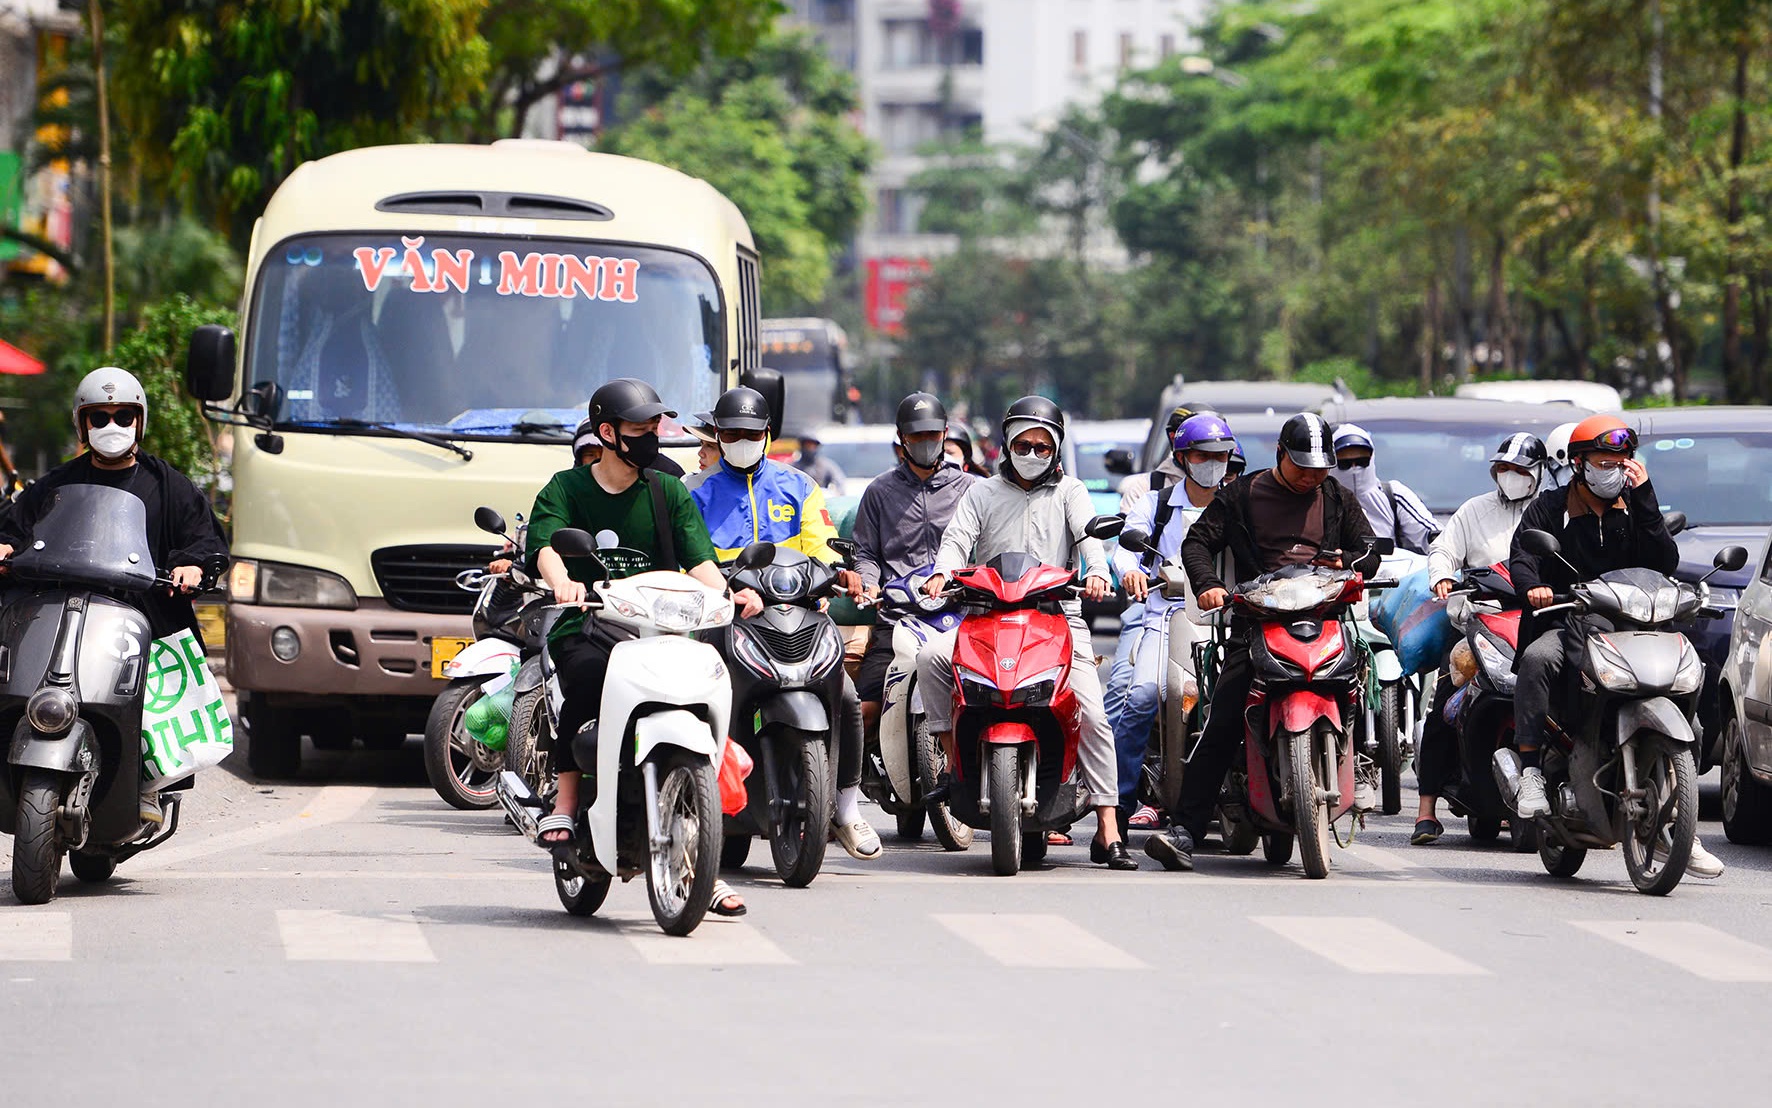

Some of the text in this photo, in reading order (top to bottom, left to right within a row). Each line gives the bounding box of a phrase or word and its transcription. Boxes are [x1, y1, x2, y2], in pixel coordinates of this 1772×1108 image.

[353, 235, 640, 302] VĂN MINH
[767, 499, 796, 522] be
